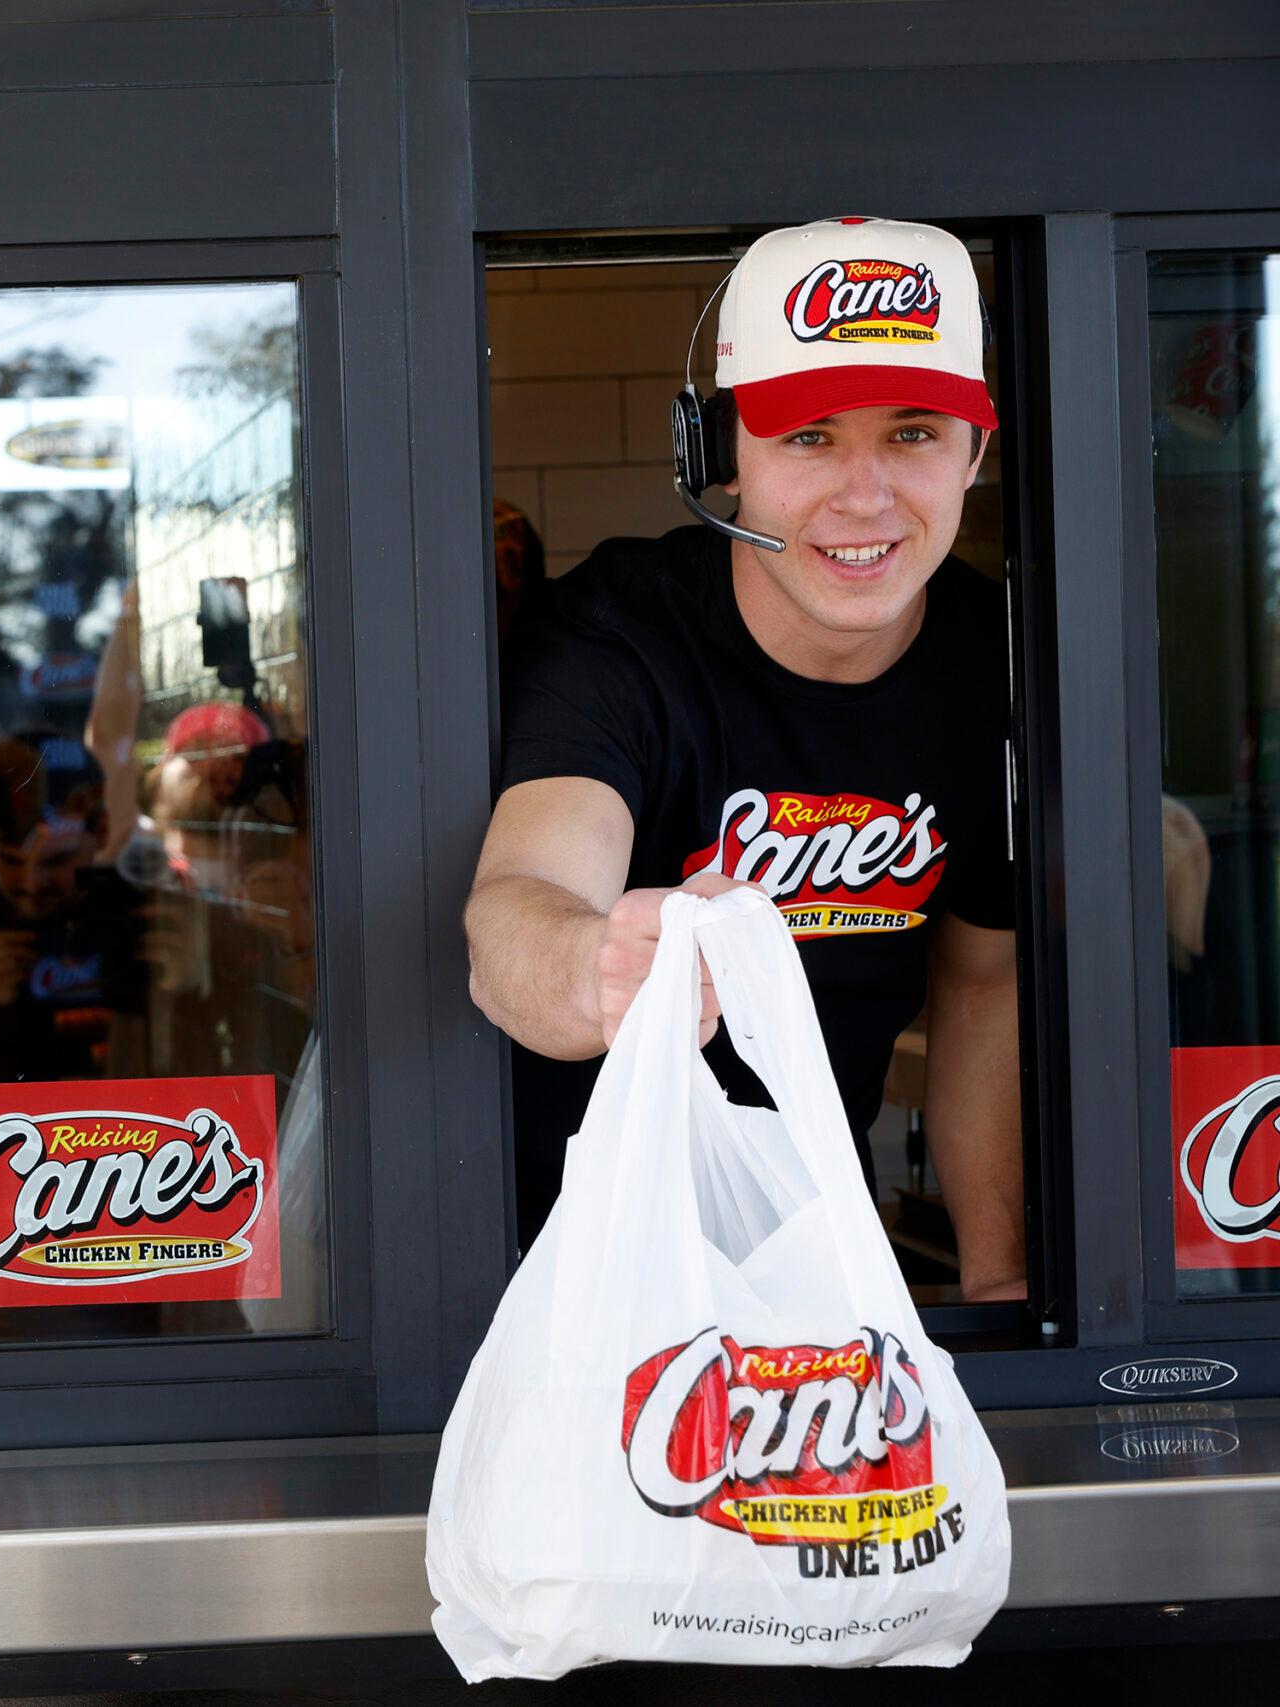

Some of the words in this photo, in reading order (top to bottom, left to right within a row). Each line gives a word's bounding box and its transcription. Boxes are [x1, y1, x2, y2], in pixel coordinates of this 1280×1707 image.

[847, 261, 903, 279] Raising
[791, 260, 939, 338] Cane's
[773, 797, 872, 828] Raising
[827, 909, 908, 928] FINGERS
[49, 1122, 158, 1155] Raising
[44, 1245, 131, 1263] CHICKEN
[138, 1241, 224, 1262] FINGERS
[1121, 1366, 1215, 1389] QUIKSERV
[857, 1487, 935, 1522] FINERS
[798, 1540, 880, 1578] ONE
